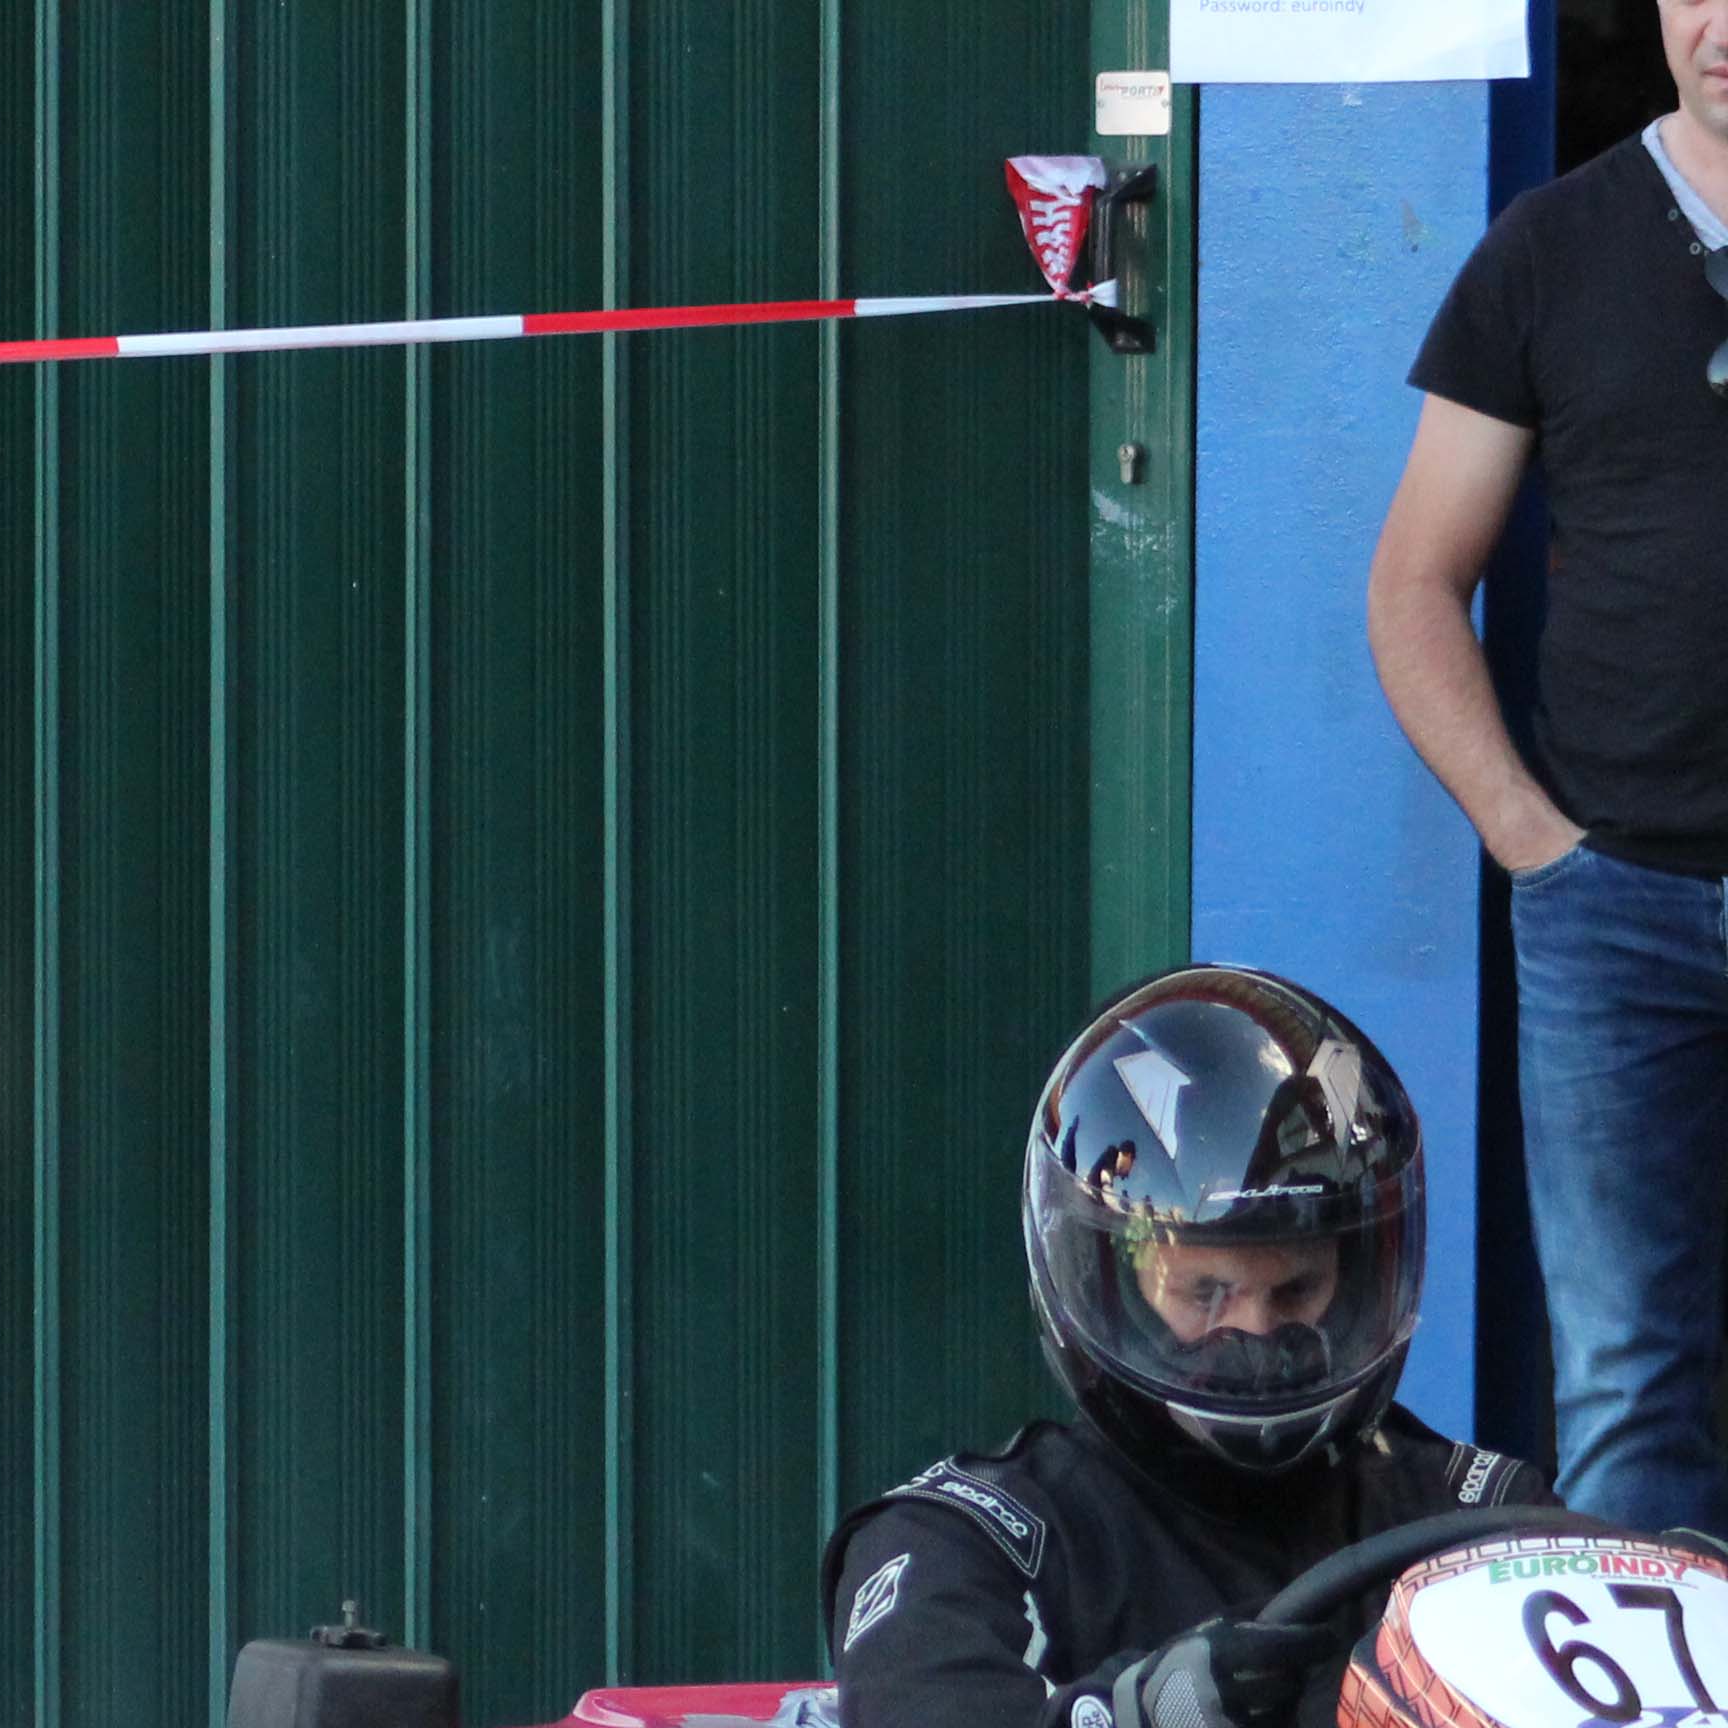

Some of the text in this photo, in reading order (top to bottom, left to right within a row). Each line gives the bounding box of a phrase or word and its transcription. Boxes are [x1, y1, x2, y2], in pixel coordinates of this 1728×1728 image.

[1290, 0, 1367, 16] euroindy
[936, 1481, 1028, 1540] sparco
[1488, 1552, 1688, 1585] EUROINDY
[1521, 1582, 1719, 1722] 67
